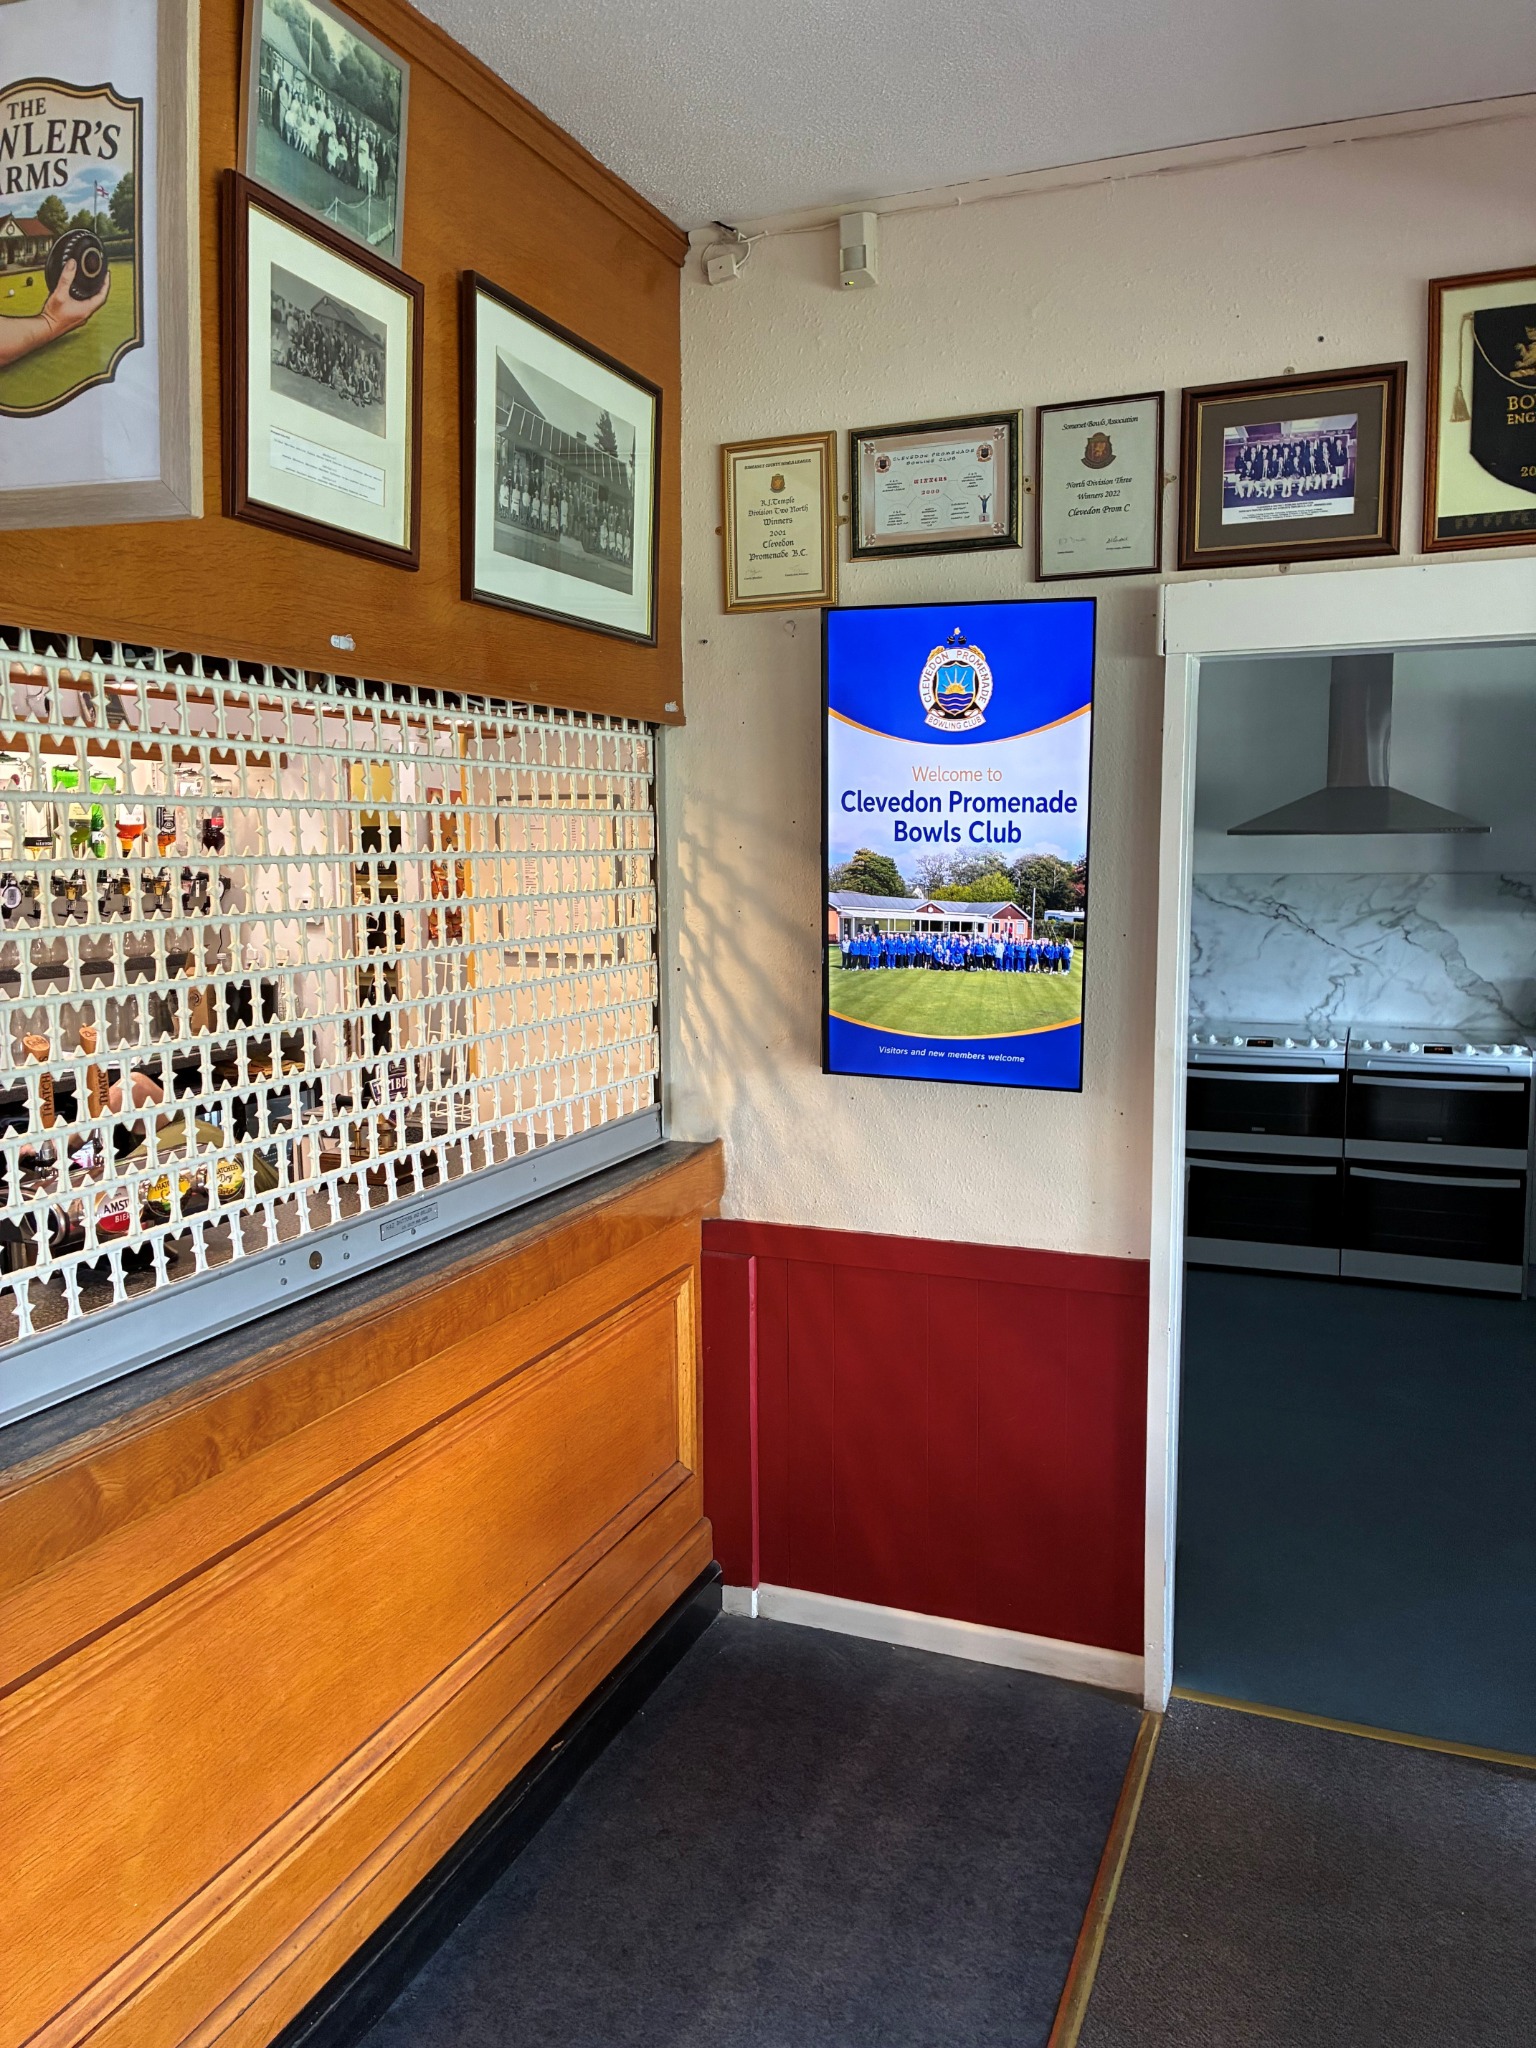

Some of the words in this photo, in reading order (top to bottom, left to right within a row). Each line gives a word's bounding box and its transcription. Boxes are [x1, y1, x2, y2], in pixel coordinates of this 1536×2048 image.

[7, 97, 46, 120] THE
[0, 158, 68, 195] RMS
[1508, 395, 1536, 410] BO
[1062, 422, 1087, 431] Somerset
[1106, 416, 1139, 426] Association
[1507, 412, 1536, 425] ENG
[893, 454, 928, 462] CLEVEDON
[931, 448, 975, 457] PROMENADE
[1066, 480, 1085, 489] North
[1086, 479, 1114, 487] Division
[1114, 476, 1132, 484] Three
[1077, 491, 1104, 500] Winners
[1105, 490, 1120, 498] 2022
[748, 509, 773, 517] Division
[774, 507, 789, 515] Two
[790, 504, 808, 513] North
[1068, 506, 1101, 517] Clevedon
[1102, 505, 1122, 514] Prom
[1123, 504, 1131, 512] C
[763, 517, 793, 525] Winners
[763, 539, 794, 549] Clevedon
[749, 550, 788, 561] Promenade
[922, 652, 949, 703] CLEVEDON
[956, 650, 990, 703] PROMENADE
[928, 716, 962, 729] BOWLING
[963, 716, 982, 728] CLUB
[912, 766, 983, 782] Welcome
[987, 767, 1003, 782] to
[841, 789, 942, 813] Clevedon
[949, 790, 1078, 813] Promenade
[894, 820, 961, 843] Bowls
[968, 820, 1022, 844] Club
[878, 1046, 909, 1055] Visitors
[910, 1048, 926, 1056] and
[947, 1051, 985, 1060] members
[988, 1054, 1026, 1063] welcome
